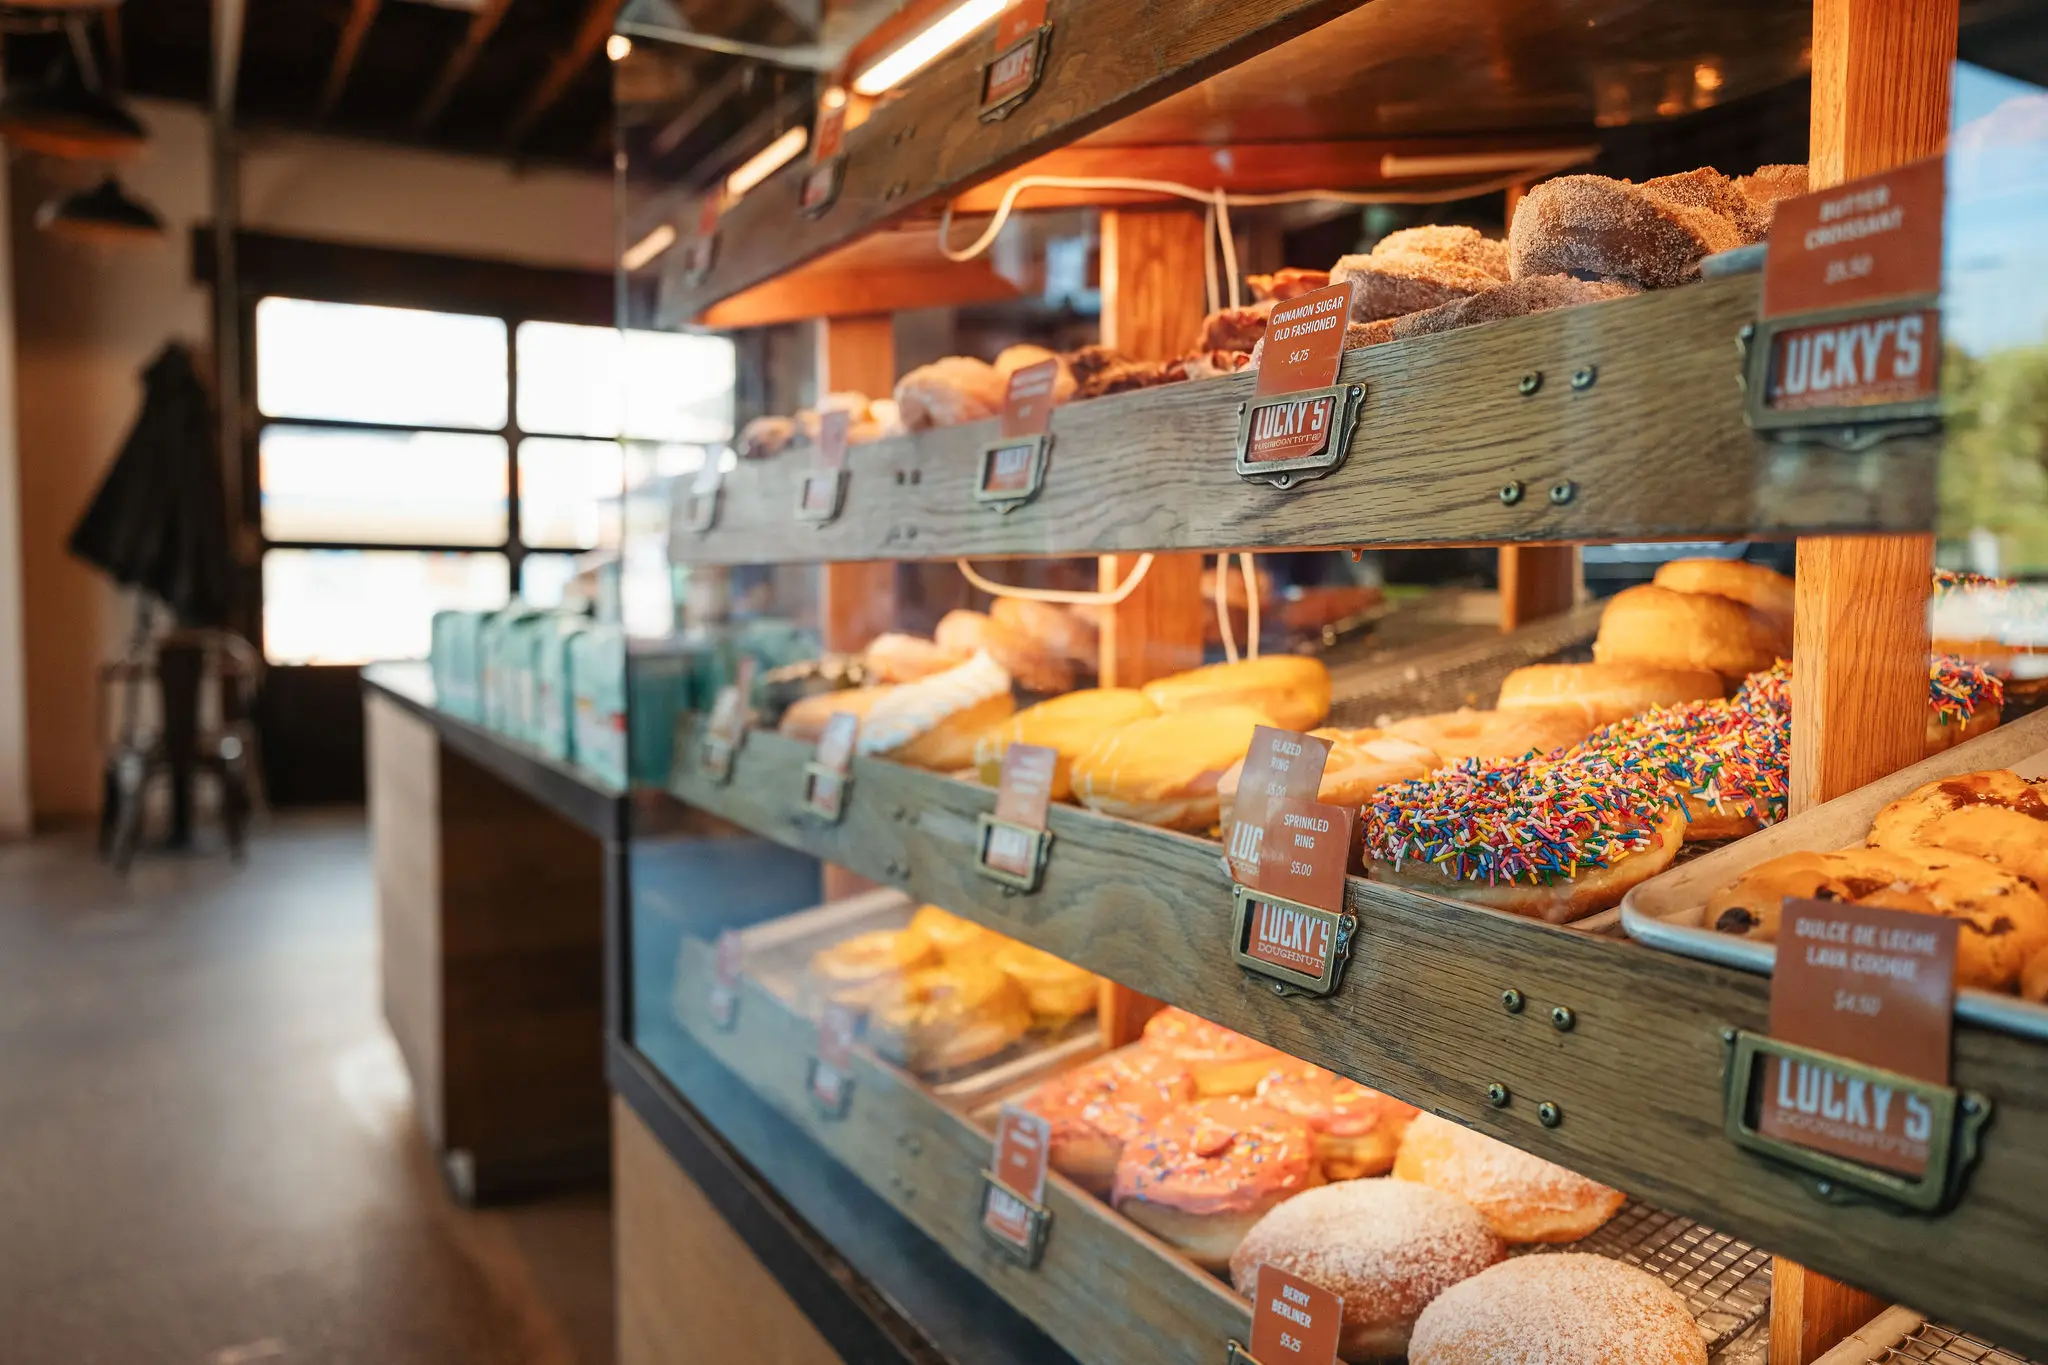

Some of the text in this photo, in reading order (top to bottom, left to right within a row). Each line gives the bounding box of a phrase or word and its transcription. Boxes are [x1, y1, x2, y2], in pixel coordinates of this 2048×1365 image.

[1273, 295, 1344, 325] CINNAMON SUGAR
[1274, 316, 1337, 342] OLD FASHIONED
[1774, 315, 1923, 395] UCKY'S
[1272, 739, 1302, 756] GLAZED
[1270, 756, 1290, 772] RING
[1284, 814, 1329, 833] SPRINKLED
[1294, 834, 1314, 849] RING
[1290, 860, 1312, 876] $5.00
[1259, 904, 1330, 953] LUCKY'S
[1794, 917, 1849, 943] DULCE
[1852, 924, 1876, 947] DE
[1776, 1057, 1931, 1142] LUCKYS
[1282, 1284, 1310, 1307] BERRY
[1271, 1298, 1312, 1329] BERLINER
